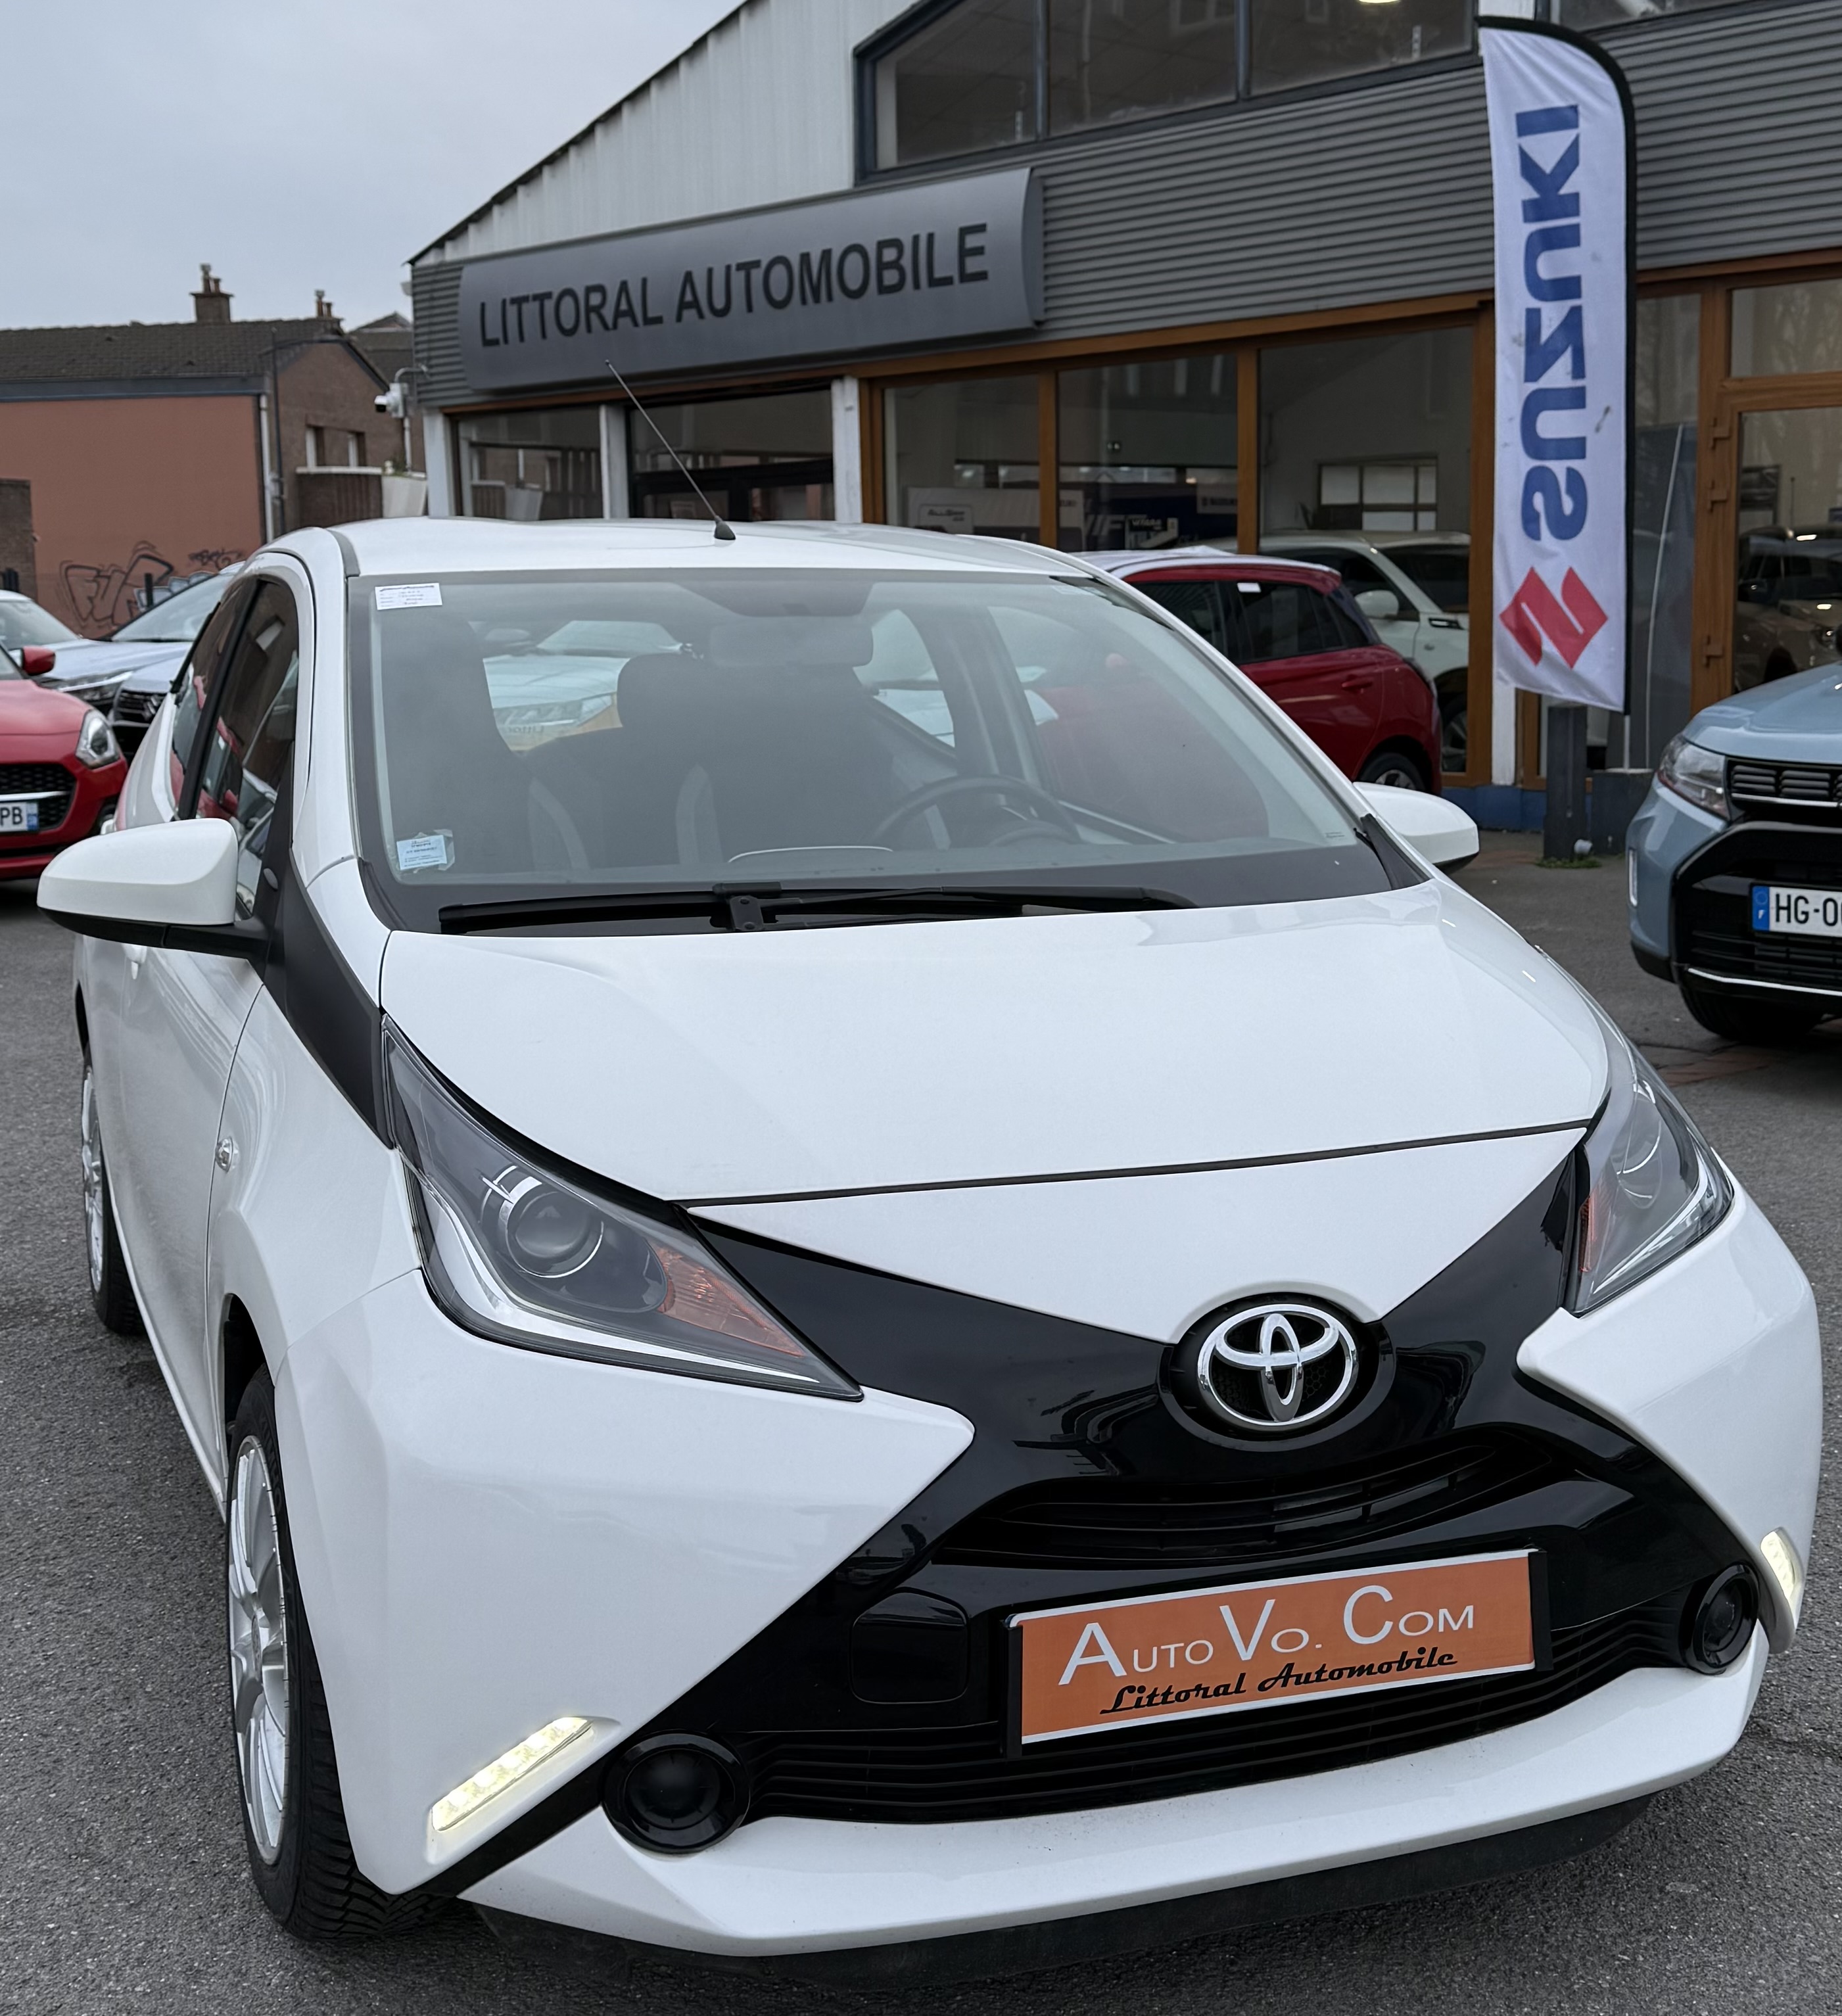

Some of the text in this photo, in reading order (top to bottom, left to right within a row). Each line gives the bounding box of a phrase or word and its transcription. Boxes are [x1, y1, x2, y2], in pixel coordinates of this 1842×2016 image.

[480, 223, 989, 347] LITTORAL AUTOMOBILE
[1776, 893, 1842, 927] HG-0
[1100, 1647, 1457, 1714] Littoral Automobile
